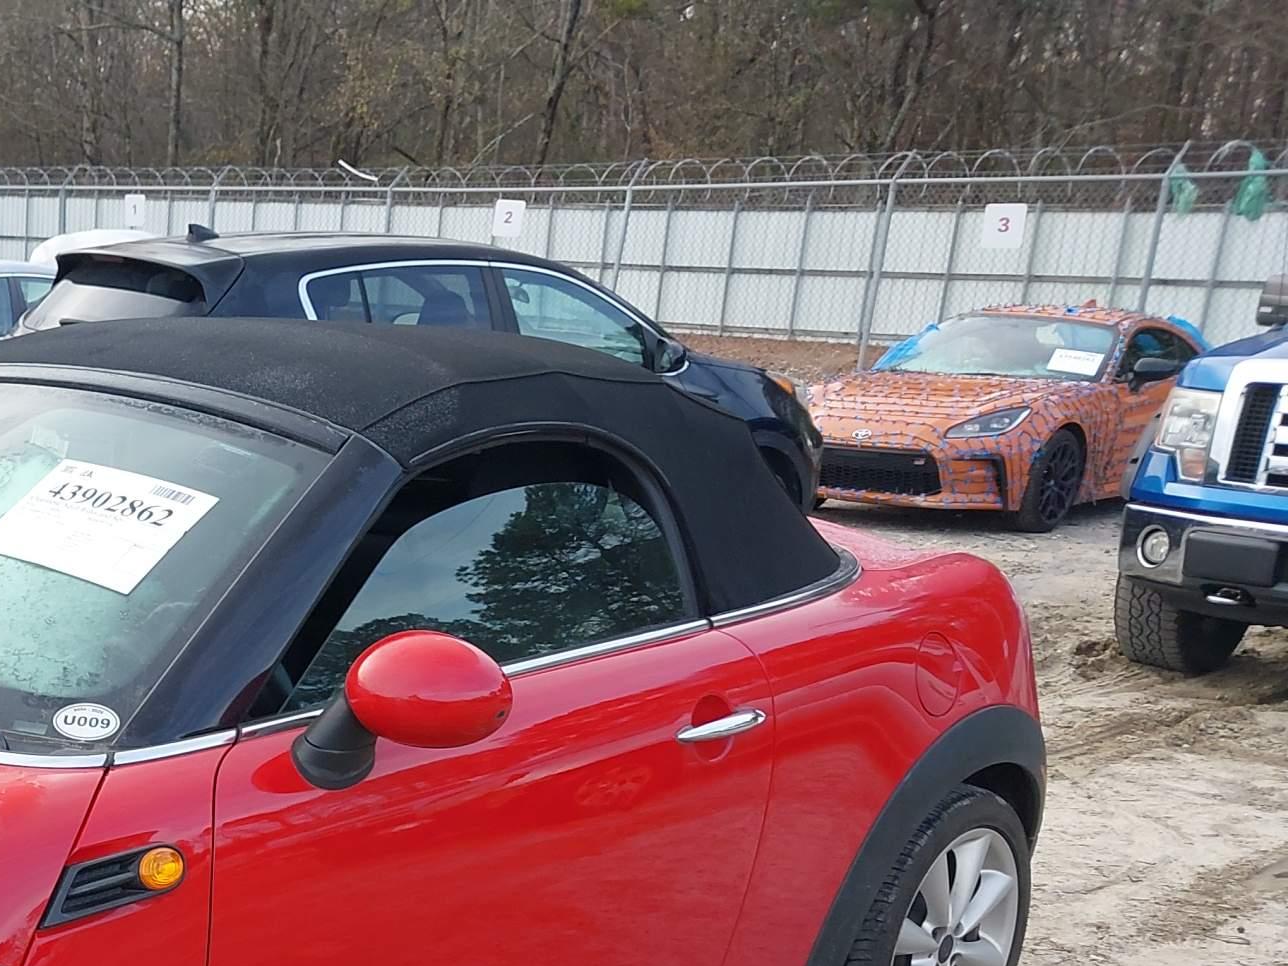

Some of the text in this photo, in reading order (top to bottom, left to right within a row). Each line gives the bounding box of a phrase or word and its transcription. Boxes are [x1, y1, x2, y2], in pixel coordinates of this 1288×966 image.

[503, 211, 513, 224] 2
[997, 217, 1010, 233] 3
[48, 482, 174, 527] 43902862
[63, 714, 111, 729] U009
